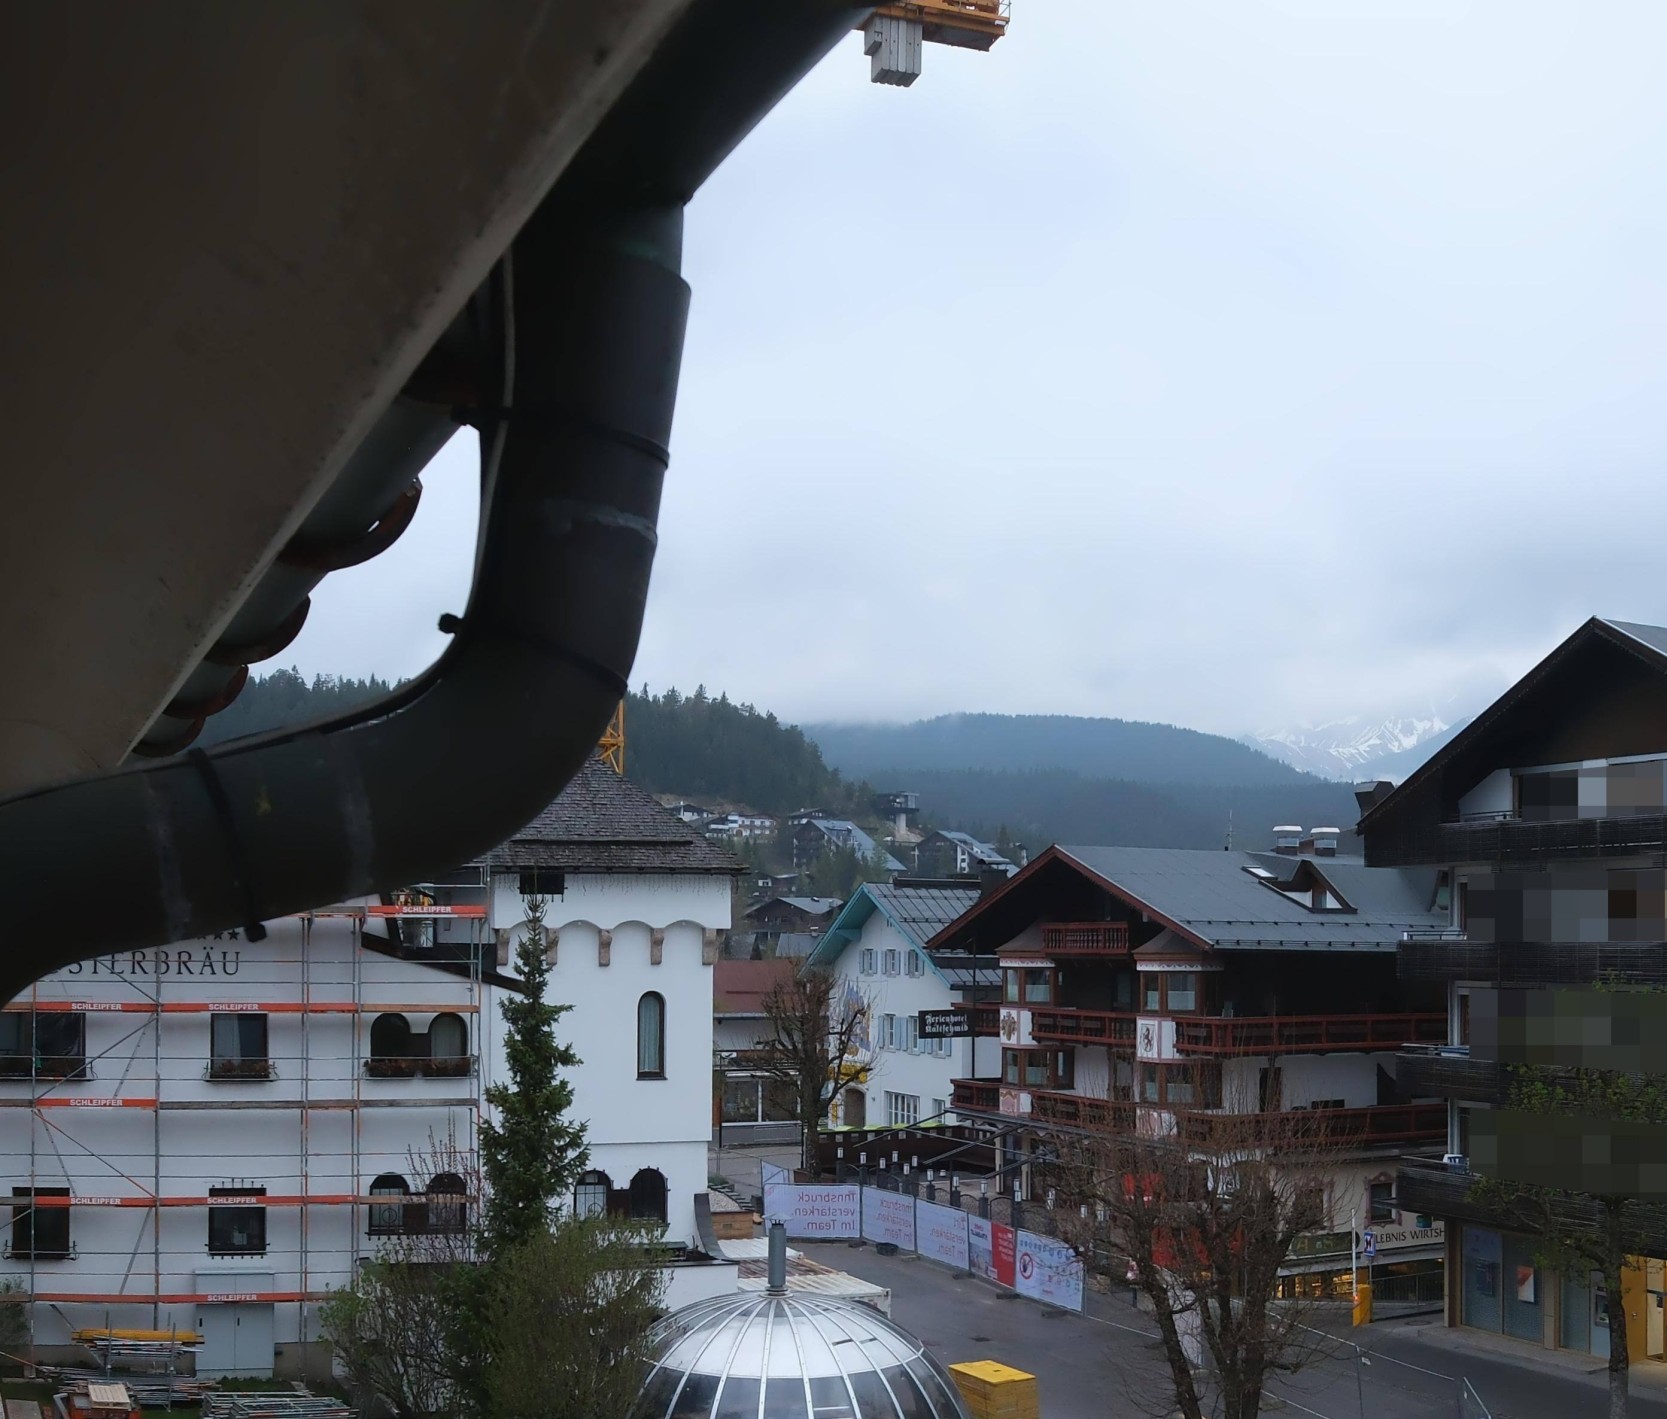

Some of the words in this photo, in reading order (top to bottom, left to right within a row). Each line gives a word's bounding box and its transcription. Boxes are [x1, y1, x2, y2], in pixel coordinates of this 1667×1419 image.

[402, 905, 452, 914] SCHLEIPFER
[48, 946, 241, 976] STERBRÄU
[71, 1002, 122, 1011] SCHLEIPFER
[208, 1002, 259, 1011] SCHLEIPFER
[70, 1197, 122, 1205] SCHLEIPFER
[207, 1196, 257, 1204] SCHLEIPFER
